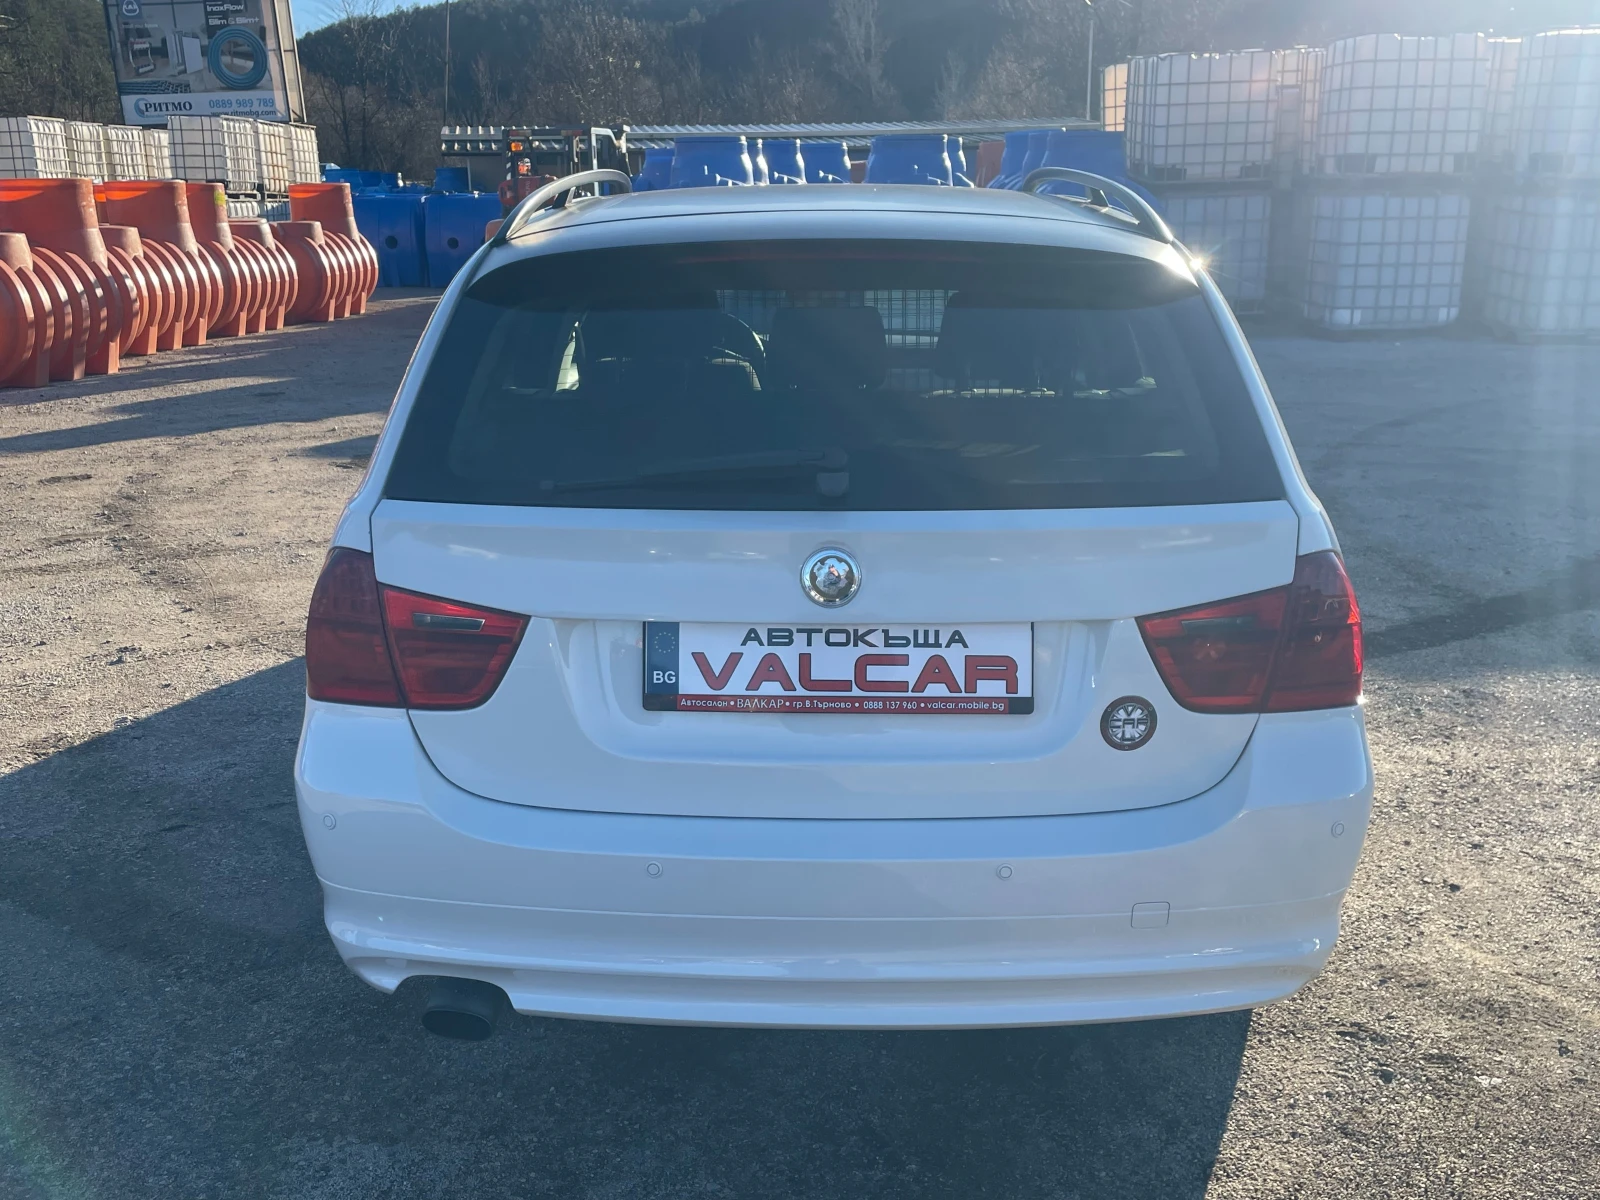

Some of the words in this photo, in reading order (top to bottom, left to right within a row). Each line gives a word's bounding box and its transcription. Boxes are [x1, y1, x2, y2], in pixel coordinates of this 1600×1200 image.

[143, 101, 193, 113] РИТМО
[208, 99, 233, 109] 0889
[235, 98, 254, 108] 989
[256, 98, 275, 108] 789
[210, 109, 277, 118] www.ritmobg.com
[740, 627, 970, 649] АВТОКЪЩА
[653, 670, 676, 684] BG
[691, 652, 1019, 694] VALCAR
[680, 698, 728, 707] Автосалон
[736, 698, 784, 709] ВАЛКАР
[863, 701, 883, 710] 0888
[886, 701, 900, 710] 137
[902, 701, 917, 710] 960
[927, 700, 1005, 711] valcar.mobile.bg
